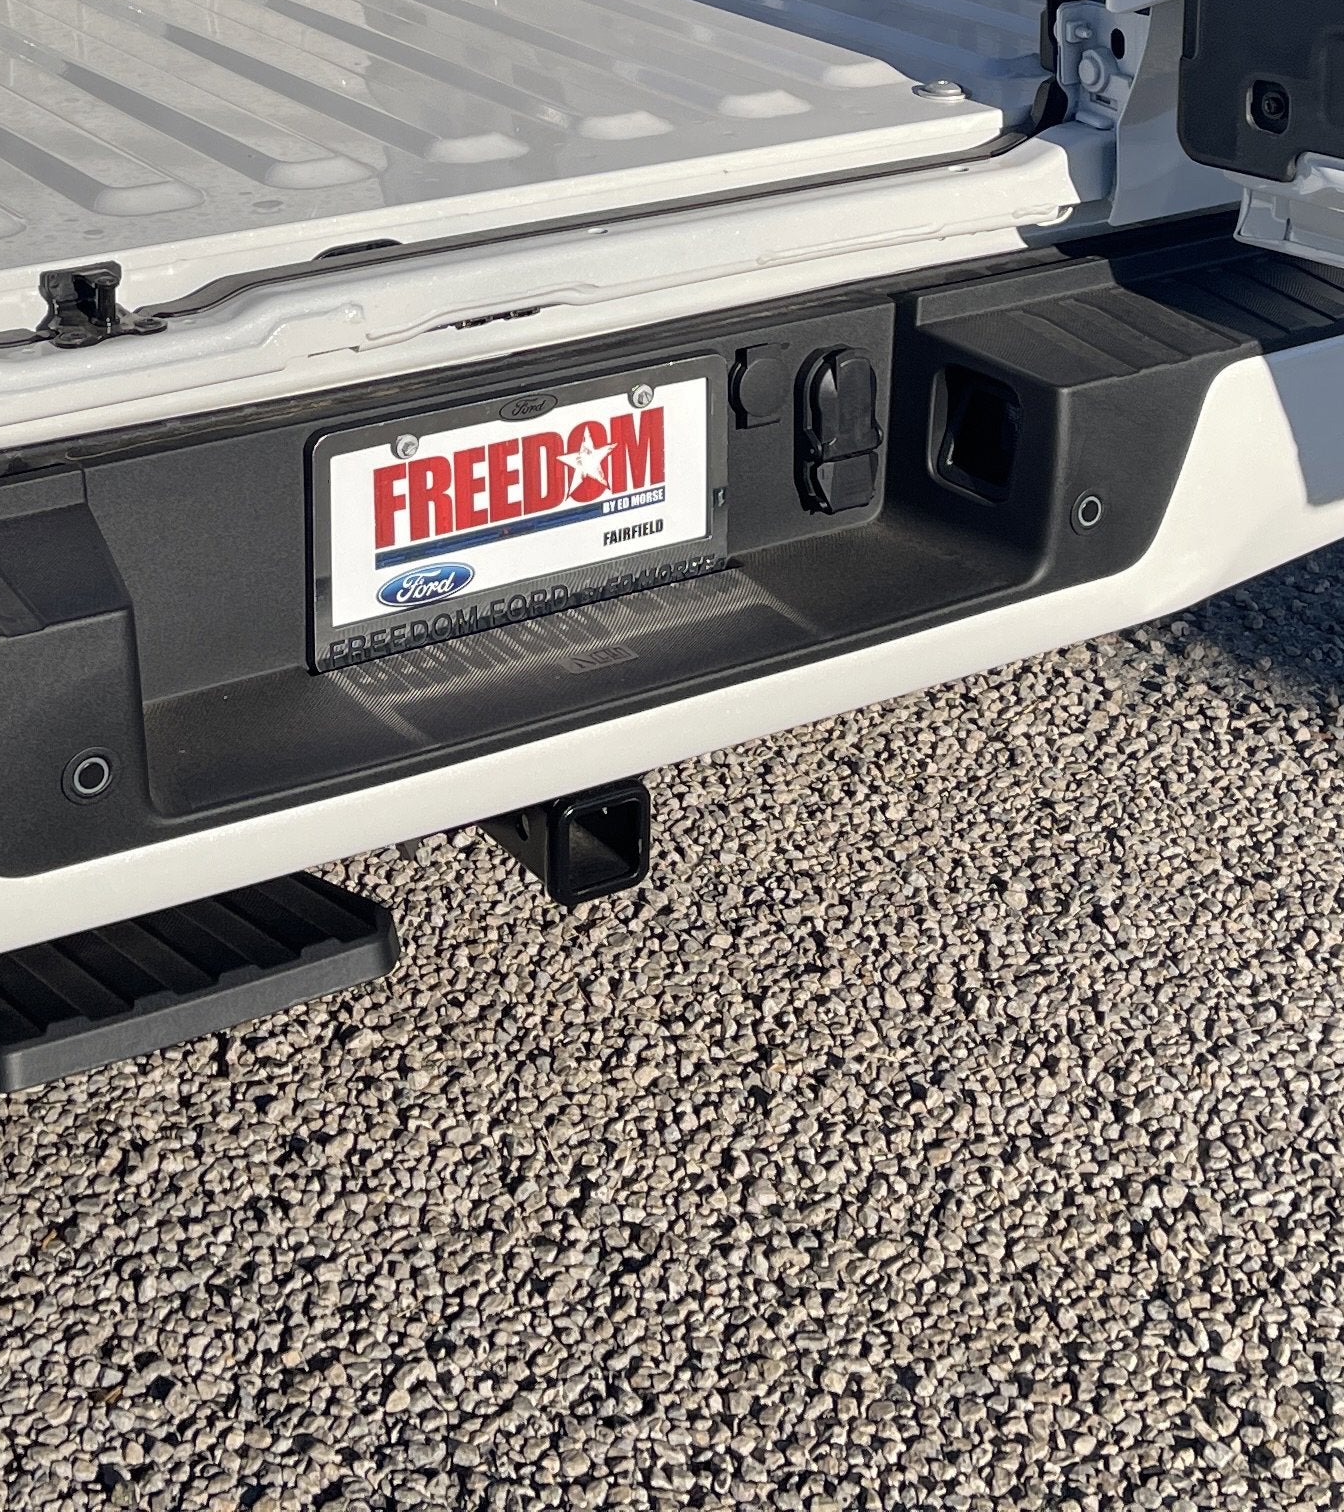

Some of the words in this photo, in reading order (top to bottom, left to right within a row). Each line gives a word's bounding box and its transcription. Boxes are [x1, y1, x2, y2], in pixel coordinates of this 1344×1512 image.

[512, 397, 547, 417] Ford
[373, 406, 665, 549] FREEDOM
[602, 500, 616, 514] BY
[617, 497, 630, 511] ED
[630, 488, 664, 507] MORSE
[603, 518, 664, 546] FAIRFIELD
[396, 570, 455, 603] Ford
[329, 604, 480, 668] FREEDOM
[490, 583, 570, 628] FORD
